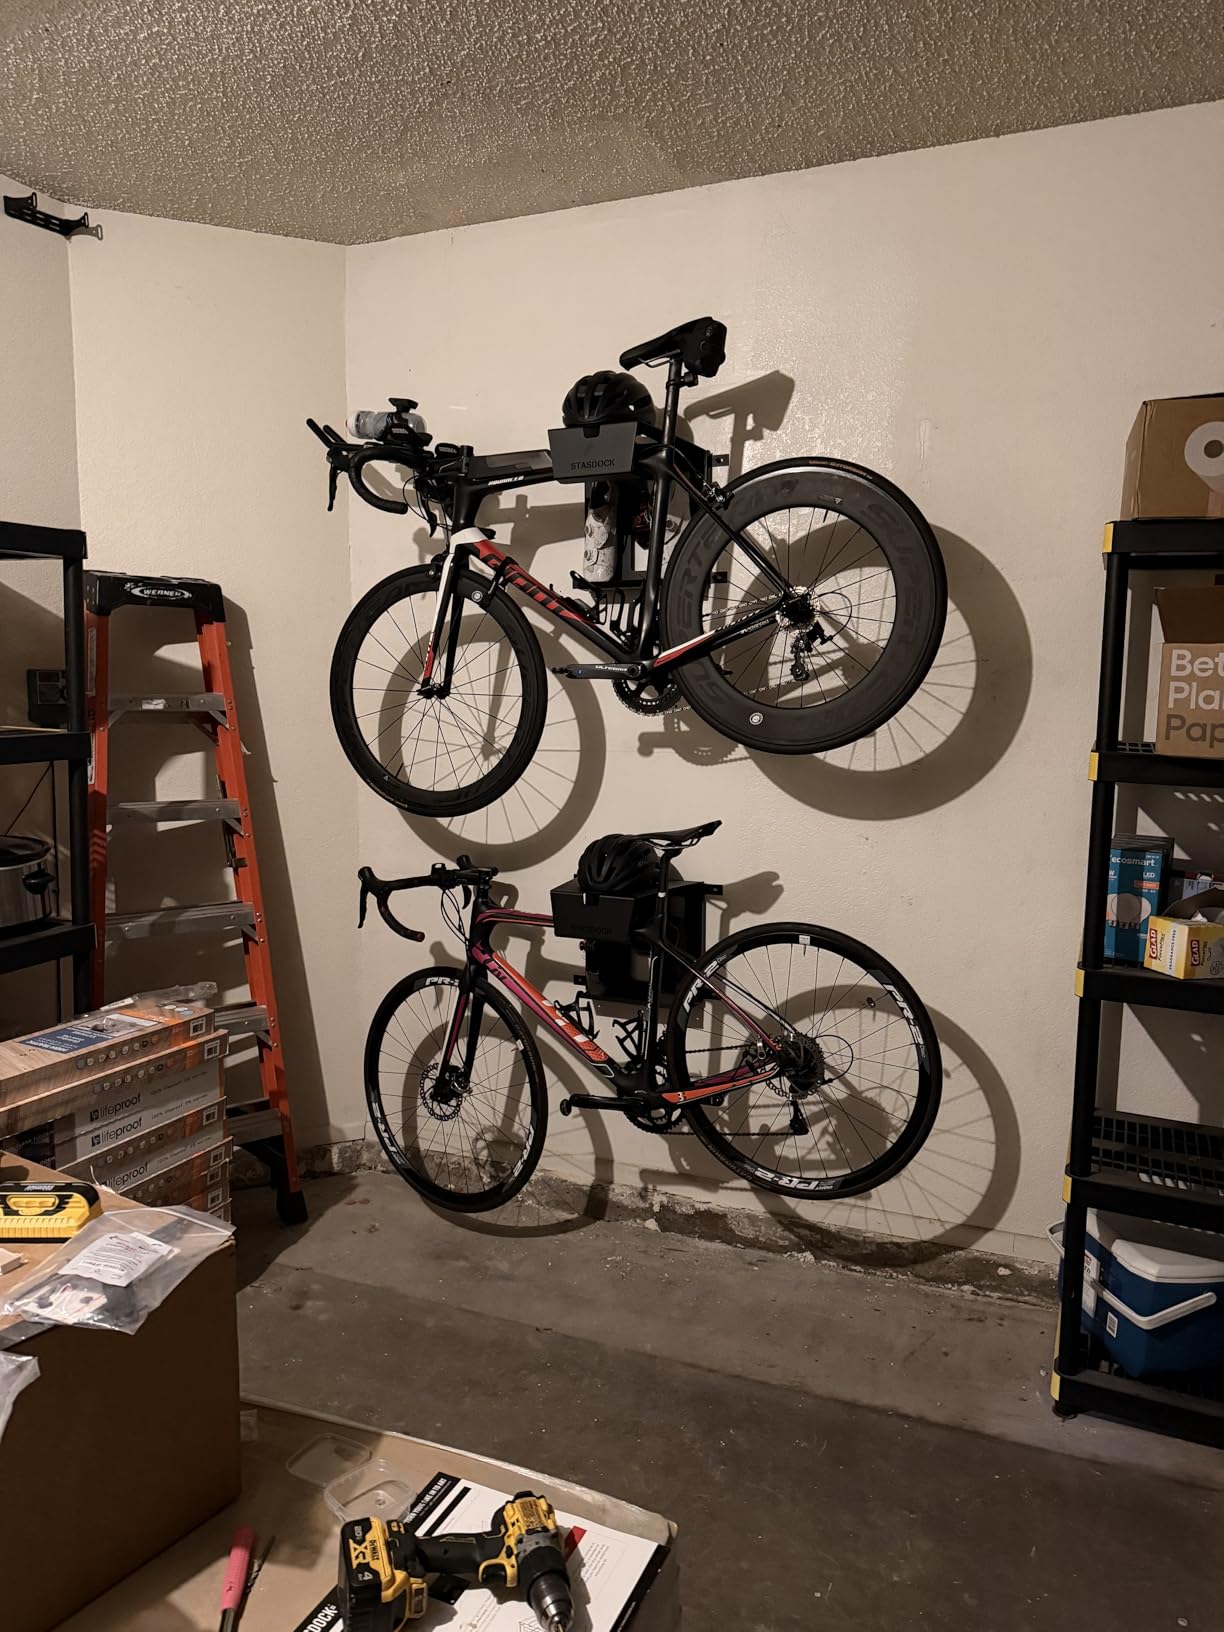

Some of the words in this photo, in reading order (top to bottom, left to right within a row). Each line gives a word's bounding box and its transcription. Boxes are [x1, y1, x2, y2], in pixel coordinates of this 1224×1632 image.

[570, 458, 615, 470] STASDOCK
[143, 589, 181, 597] WERNER
[1169, 649, 1224, 677] Bet
[1167, 681, 1224, 710] Pla
[1164, 713, 1224, 749] Pap
[1111, 856, 1156, 867] ecosmart
[1191, 940, 1200, 965] GLAD
[883, 984, 924, 1047] PR-2
[99, 1093, 141, 1118] lifeproof
[101, 1116, 143, 1143] lifeproof
[107, 1162, 148, 1188] lifeproof
[754, 1167, 819, 1190] PR-2
[362, 1571, 373, 1580] 4
